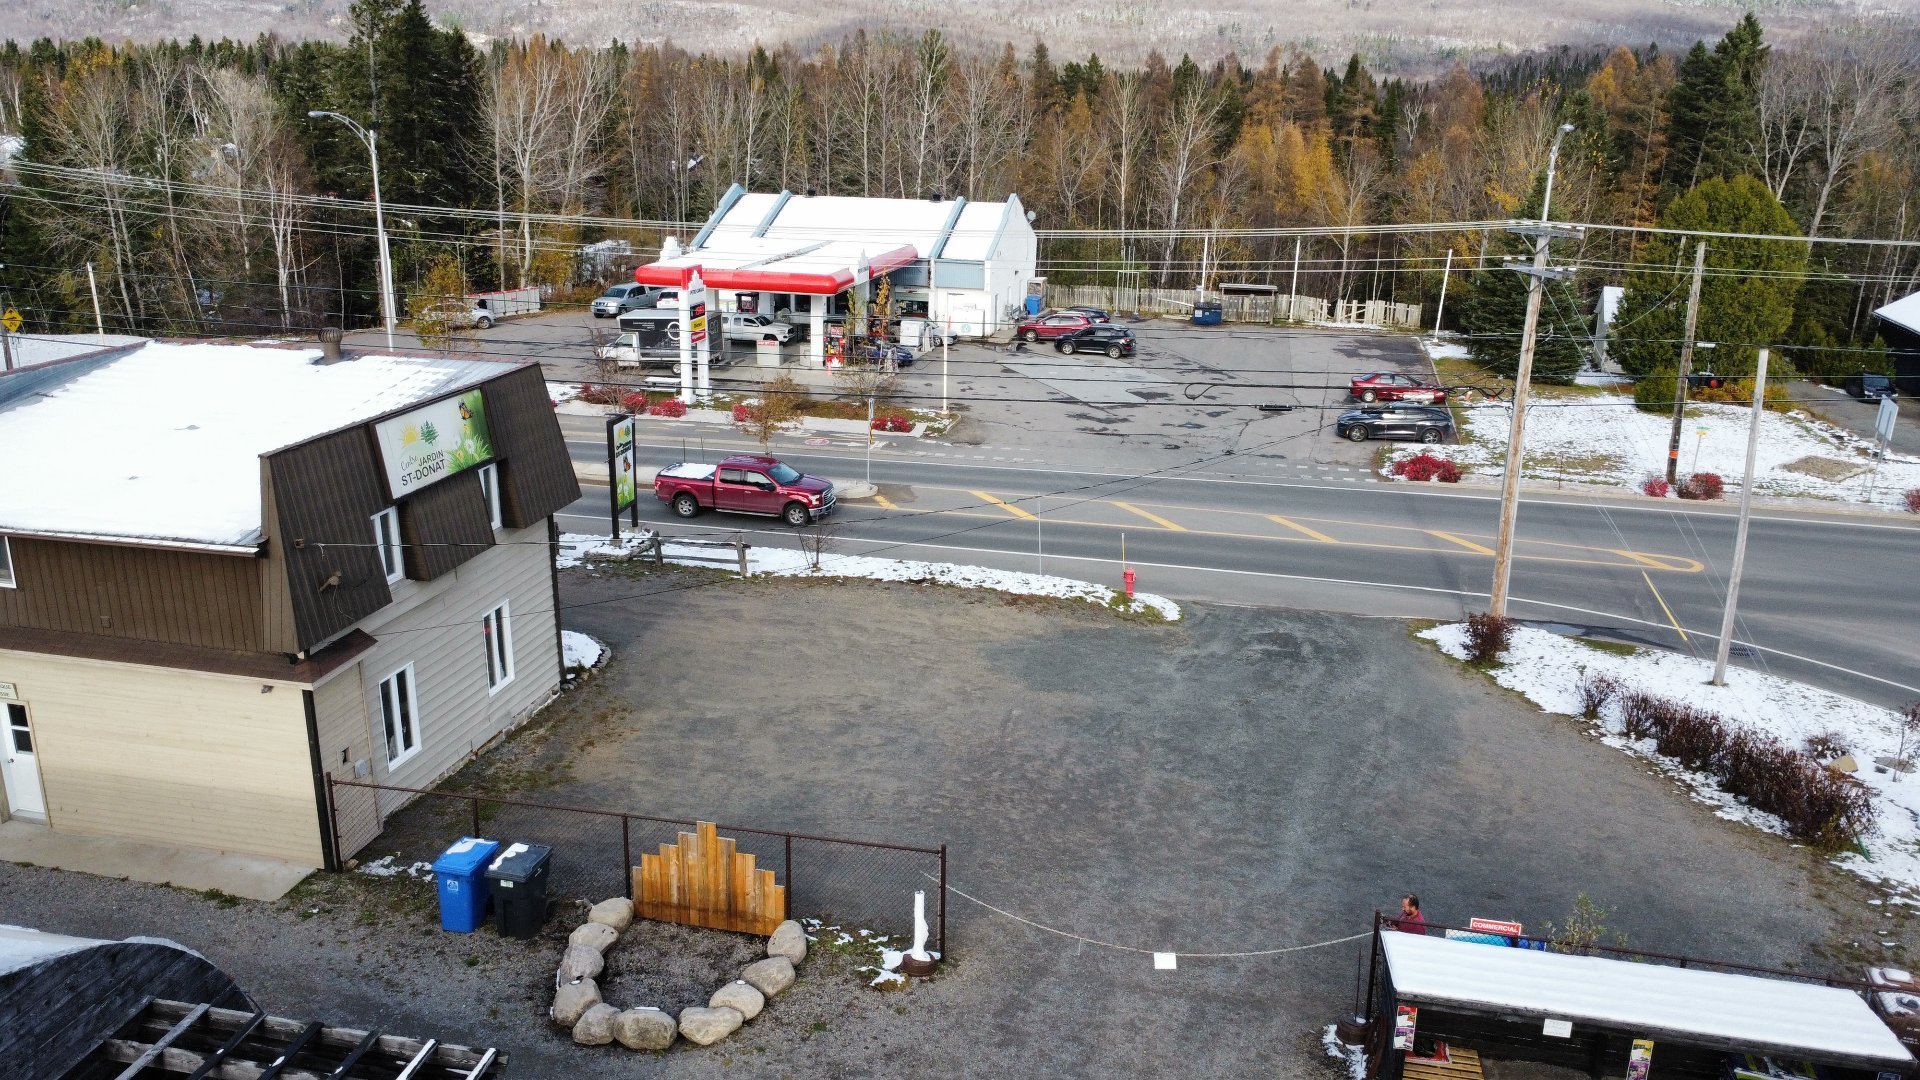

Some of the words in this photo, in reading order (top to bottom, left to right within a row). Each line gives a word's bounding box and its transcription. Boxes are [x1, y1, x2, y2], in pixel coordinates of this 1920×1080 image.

[418, 449, 445, 467] JARDIN
[401, 459, 446, 487] ST-DONAT
[1473, 921, 1519, 933] COMMERCIAL
